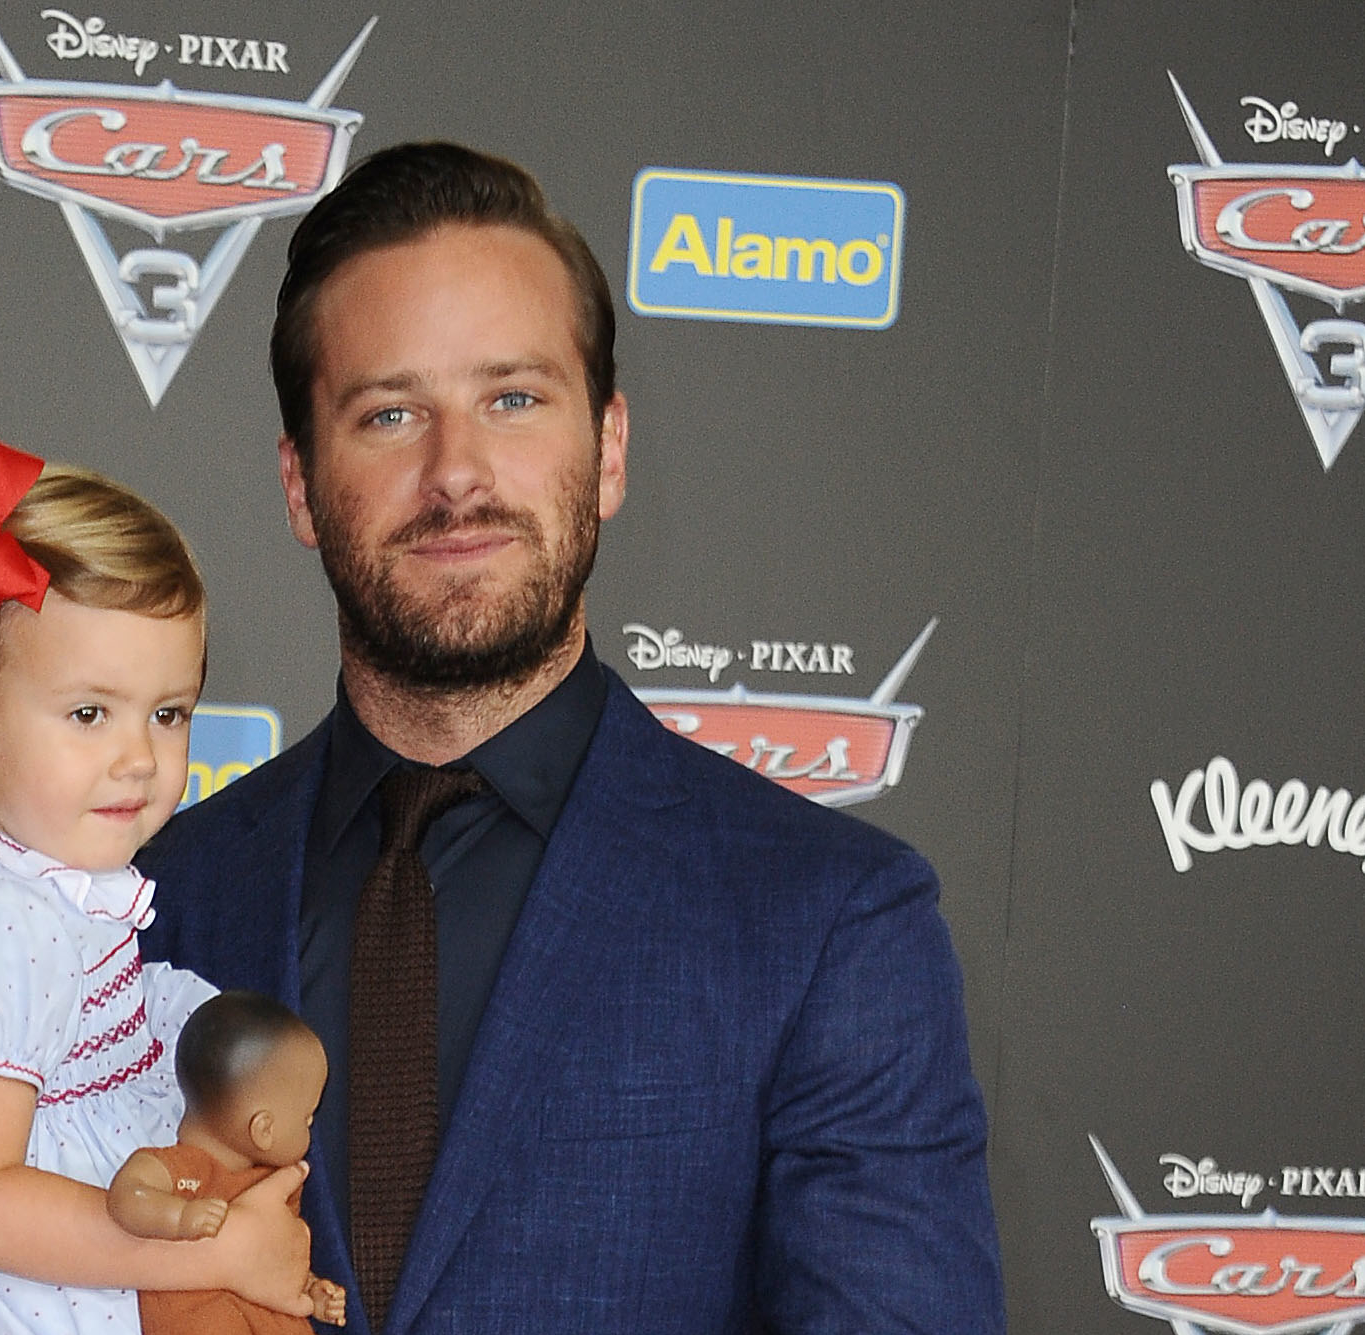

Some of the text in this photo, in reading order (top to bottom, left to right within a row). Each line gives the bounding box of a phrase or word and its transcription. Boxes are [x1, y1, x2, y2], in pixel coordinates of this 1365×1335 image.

[41, 9, 289, 76] Disney PIXAR
[22, 108, 299, 191] Cars
[1240, 96, 1347, 157] Disney
[649, 214, 883, 286] Alamo
[1216, 187, 1365, 254] Ca
[118, 249, 198, 345] 3
[623, 623, 856, 683] Disney PIXAR
[1159, 1153, 1264, 1208] Disney
